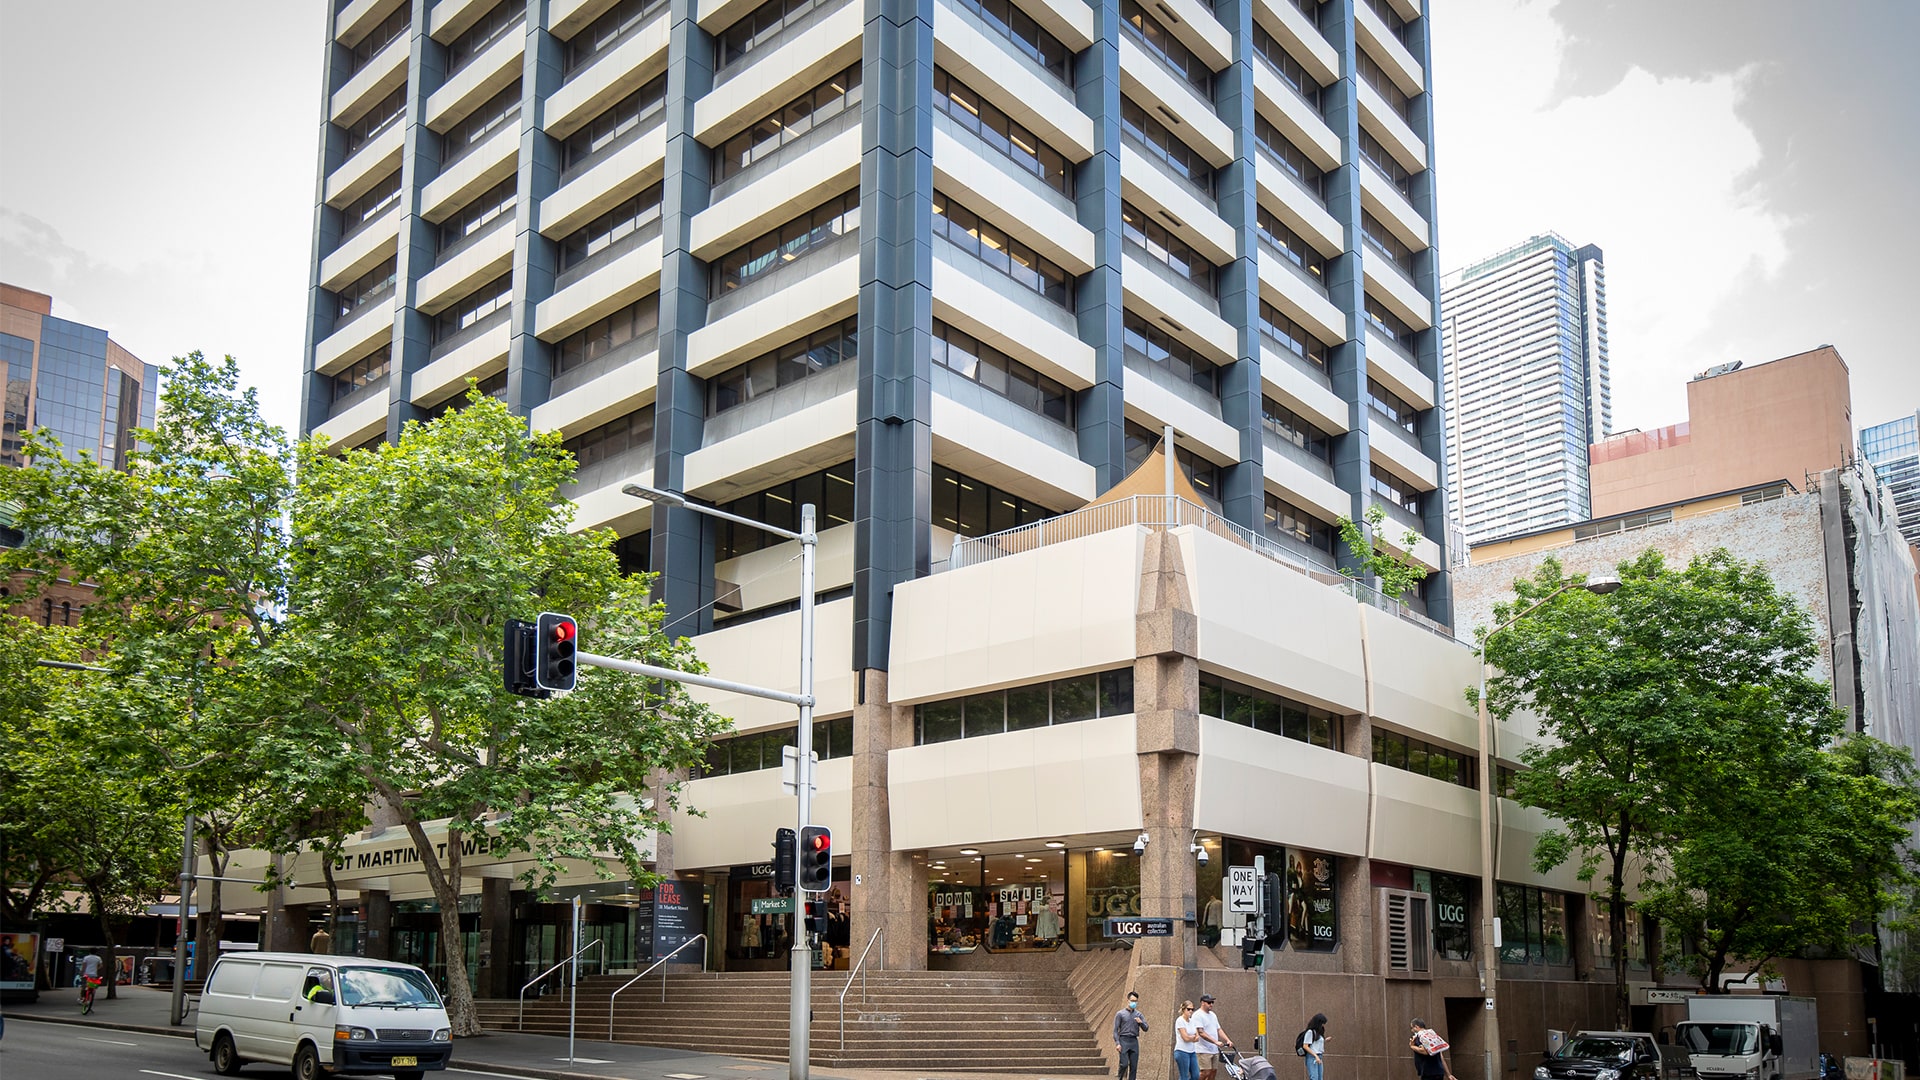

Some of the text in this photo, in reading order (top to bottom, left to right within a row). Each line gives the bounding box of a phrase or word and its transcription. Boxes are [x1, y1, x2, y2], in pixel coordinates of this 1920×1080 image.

[358, 848, 424, 868] MARTIN
[437, 836, 502, 859] TWER
[751, 865, 771, 875] UGG
[1234, 871, 1252, 881] ONE
[659, 883, 674, 893] FOR
[1232, 885, 1253, 895] WAY
[658, 893, 680, 904] LEASE
[937, 889, 1042, 905] DOWN SALE
[761, 900, 787, 909] Market St
[1439, 904, 1465, 923] UGG
[1117, 922, 1142, 934] UGG
[1313, 925, 1332, 937] UGG
